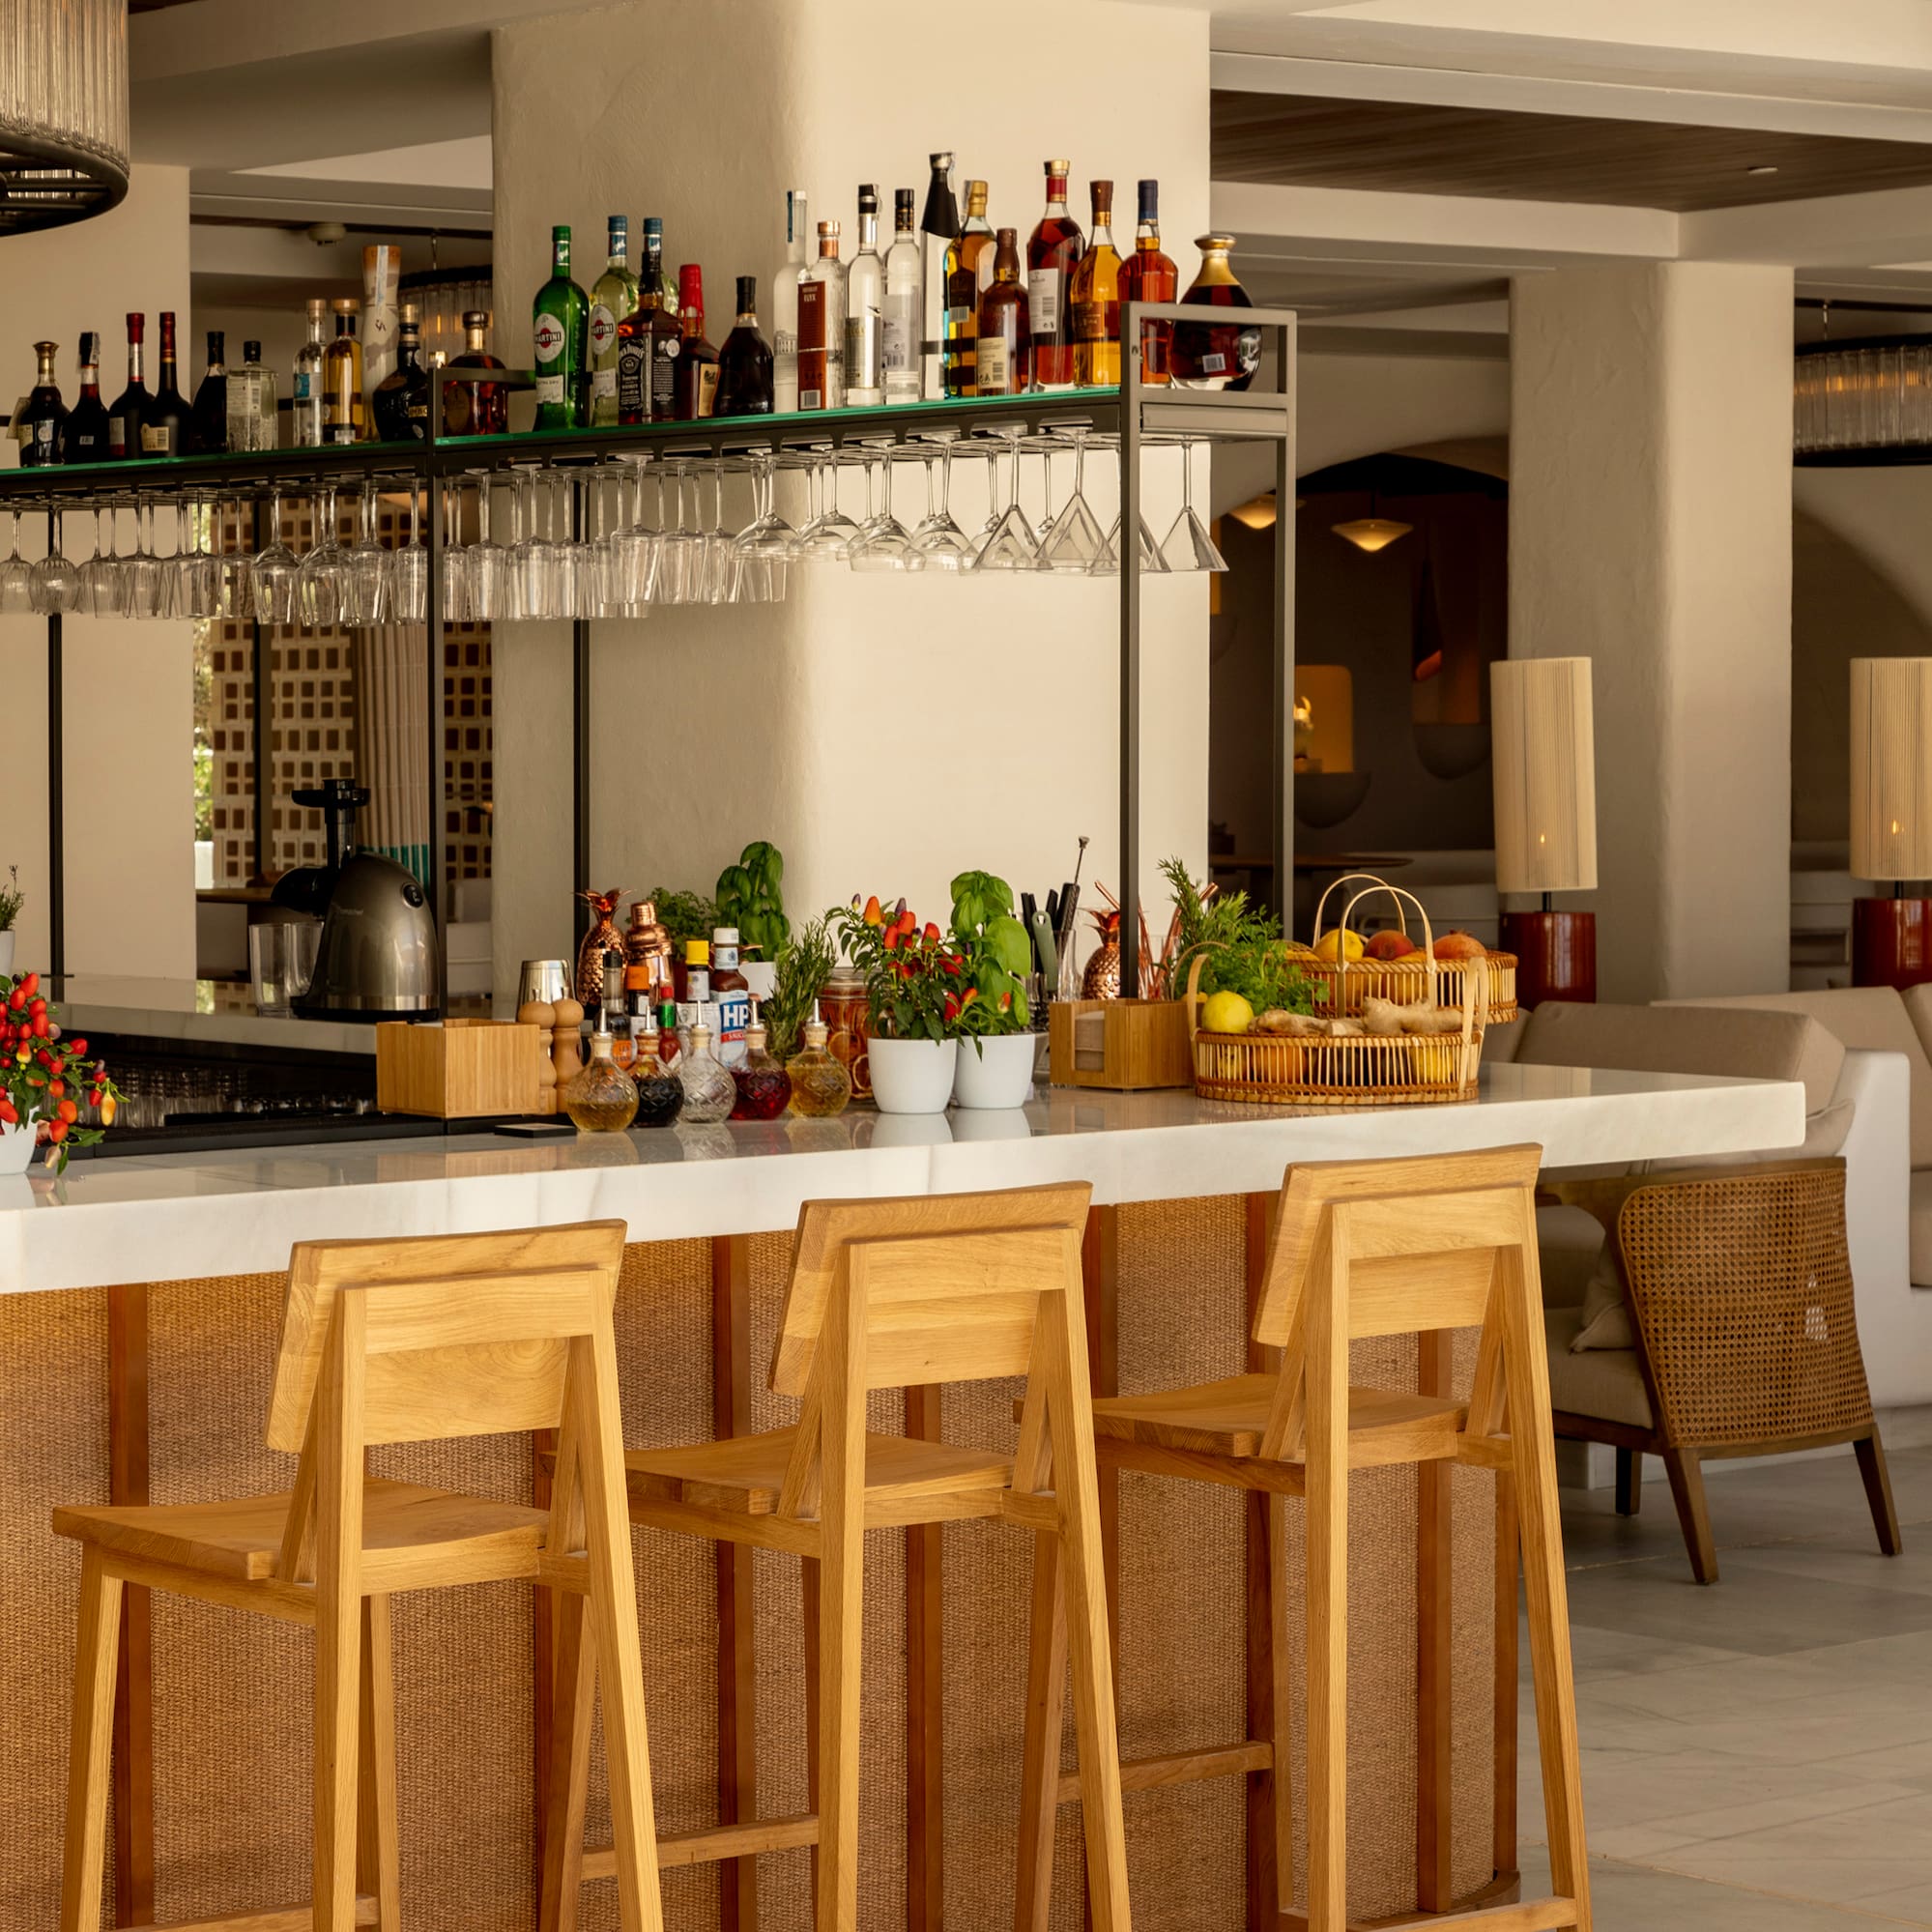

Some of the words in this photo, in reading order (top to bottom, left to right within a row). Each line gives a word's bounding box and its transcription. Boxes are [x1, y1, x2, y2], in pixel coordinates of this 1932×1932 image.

[591, 324, 614, 335] MARTINI
[534, 332, 562, 344] MARTINI
[723, 1004, 749, 1028] HP
